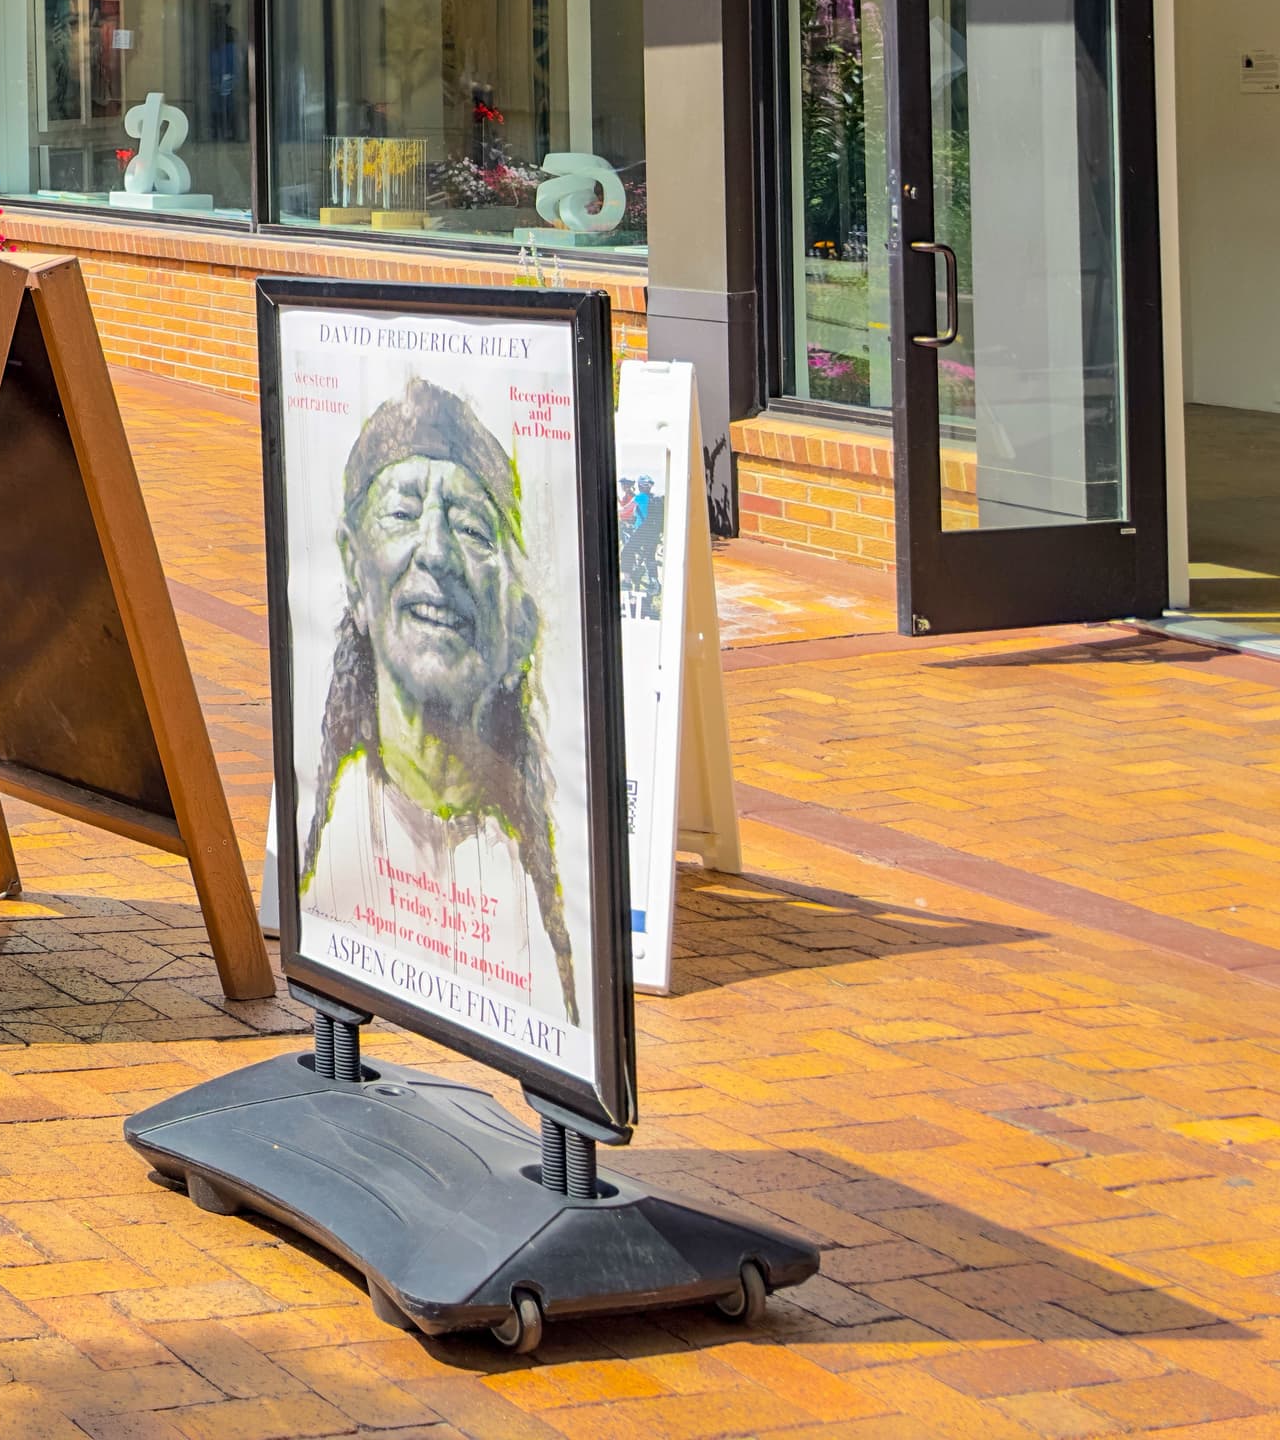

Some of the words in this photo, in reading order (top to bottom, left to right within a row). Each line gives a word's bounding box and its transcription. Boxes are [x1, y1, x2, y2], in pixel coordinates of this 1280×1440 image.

[320, 324, 371, 346] DAVID
[377, 328, 473, 355] FREDERICK
[480, 335, 532, 360] RILEY
[287, 395, 349, 416] portraiture
[509, 386, 570, 408] Reception
[529, 407, 552, 422] and
[511, 422, 533, 437] Art
[534, 422, 571, 441] Demo
[449, 882, 476, 915] July
[480, 897, 499, 918] 27
[441, 906, 468, 940] July
[471, 920, 491, 943] 28
[353, 904, 396, 935] 4-8pm
[399, 926, 415, 943] or
[416, 934, 452, 959] come
[453, 943, 468, 964] in
[470, 953, 533, 993] anytime!
[328, 934, 386, 977] ASPEN
[391, 959, 462, 1013] GROVE
[467, 990, 516, 1037] FINE
[521, 1017, 567, 1057] ART
